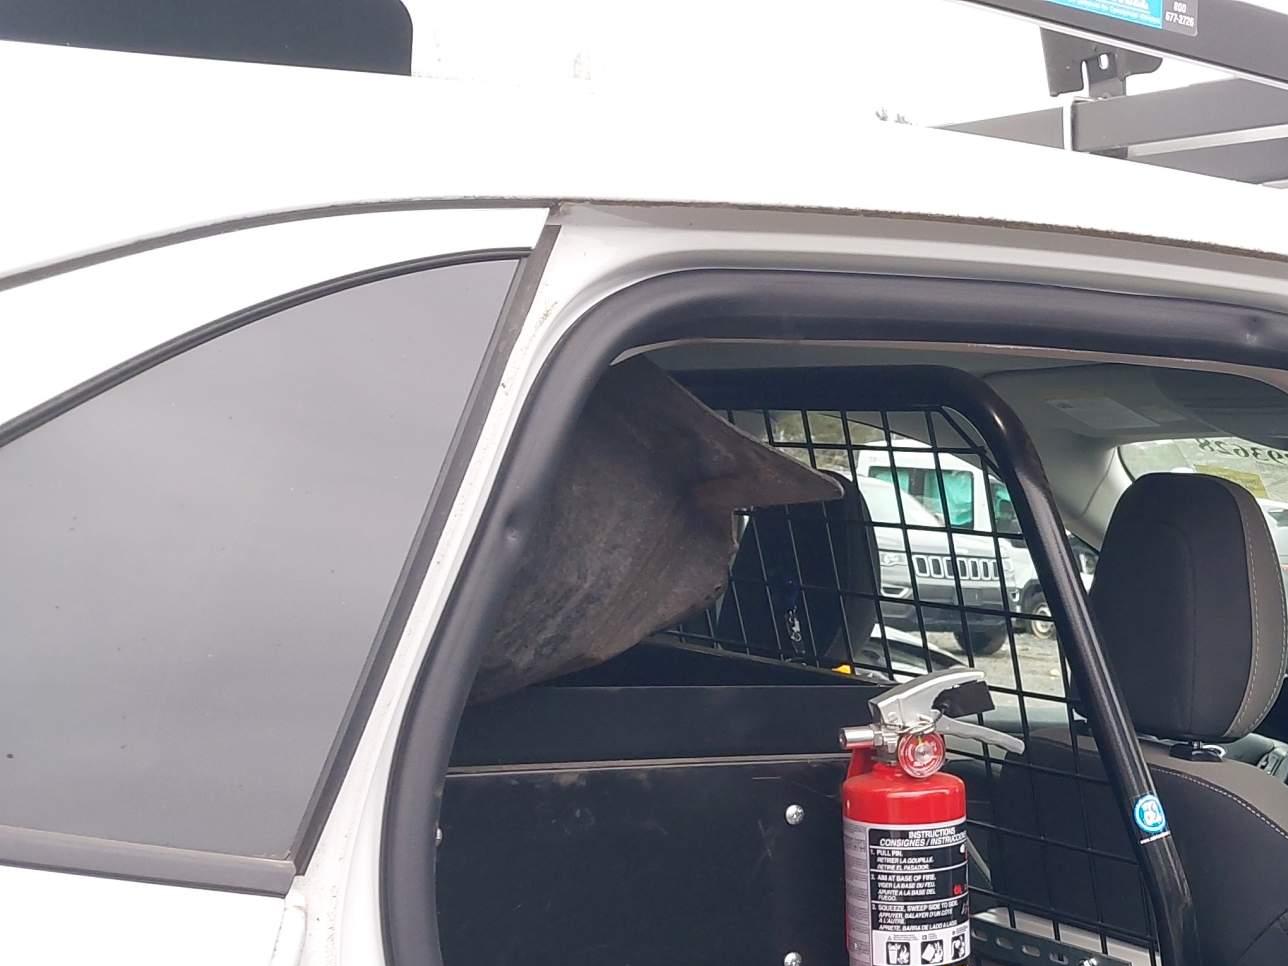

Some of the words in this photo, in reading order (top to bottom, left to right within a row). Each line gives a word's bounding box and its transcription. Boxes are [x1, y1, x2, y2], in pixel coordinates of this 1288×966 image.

[908, 827, 956, 839] INSTRUCTIONS
[880, 838, 925, 847] CONSIGNES
[876, 849, 891, 857] PULL
